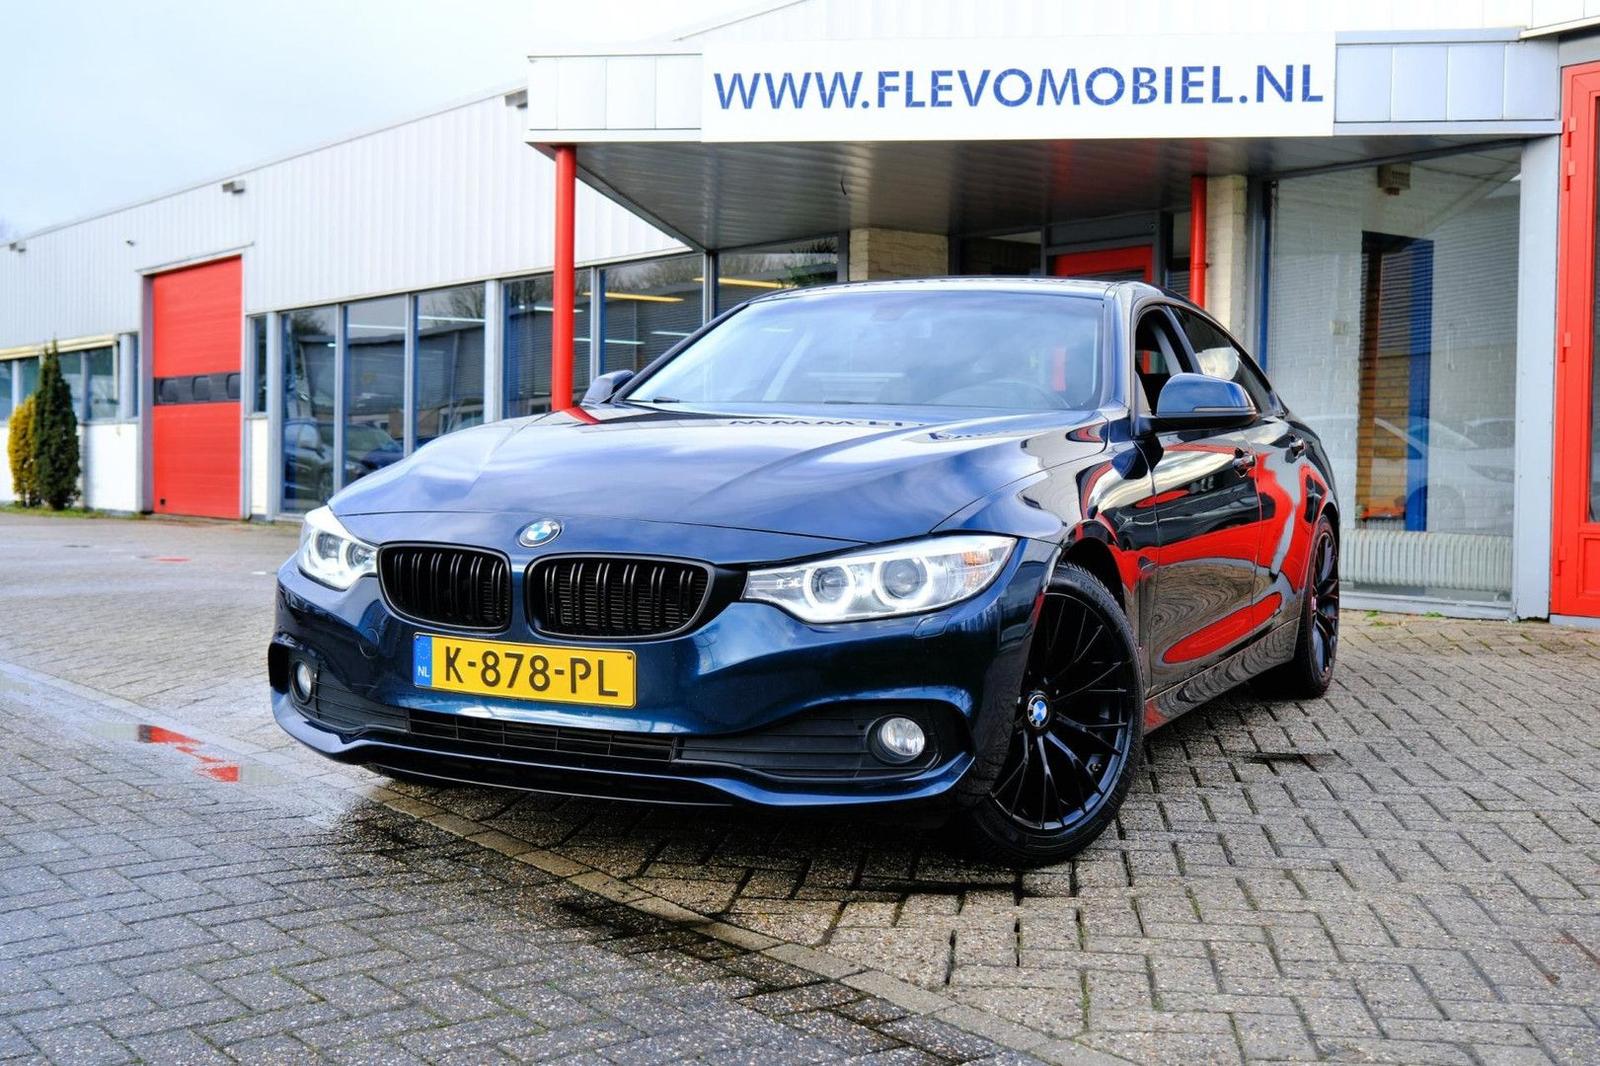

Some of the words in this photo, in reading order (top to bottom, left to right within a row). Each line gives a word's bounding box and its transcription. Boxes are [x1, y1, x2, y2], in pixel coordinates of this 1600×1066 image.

[713, 64, 1324, 109] WWW.FLEVOMOBIEL.NL
[417, 665, 430, 677] NL
[445, 646, 618, 697] K-878-PL
